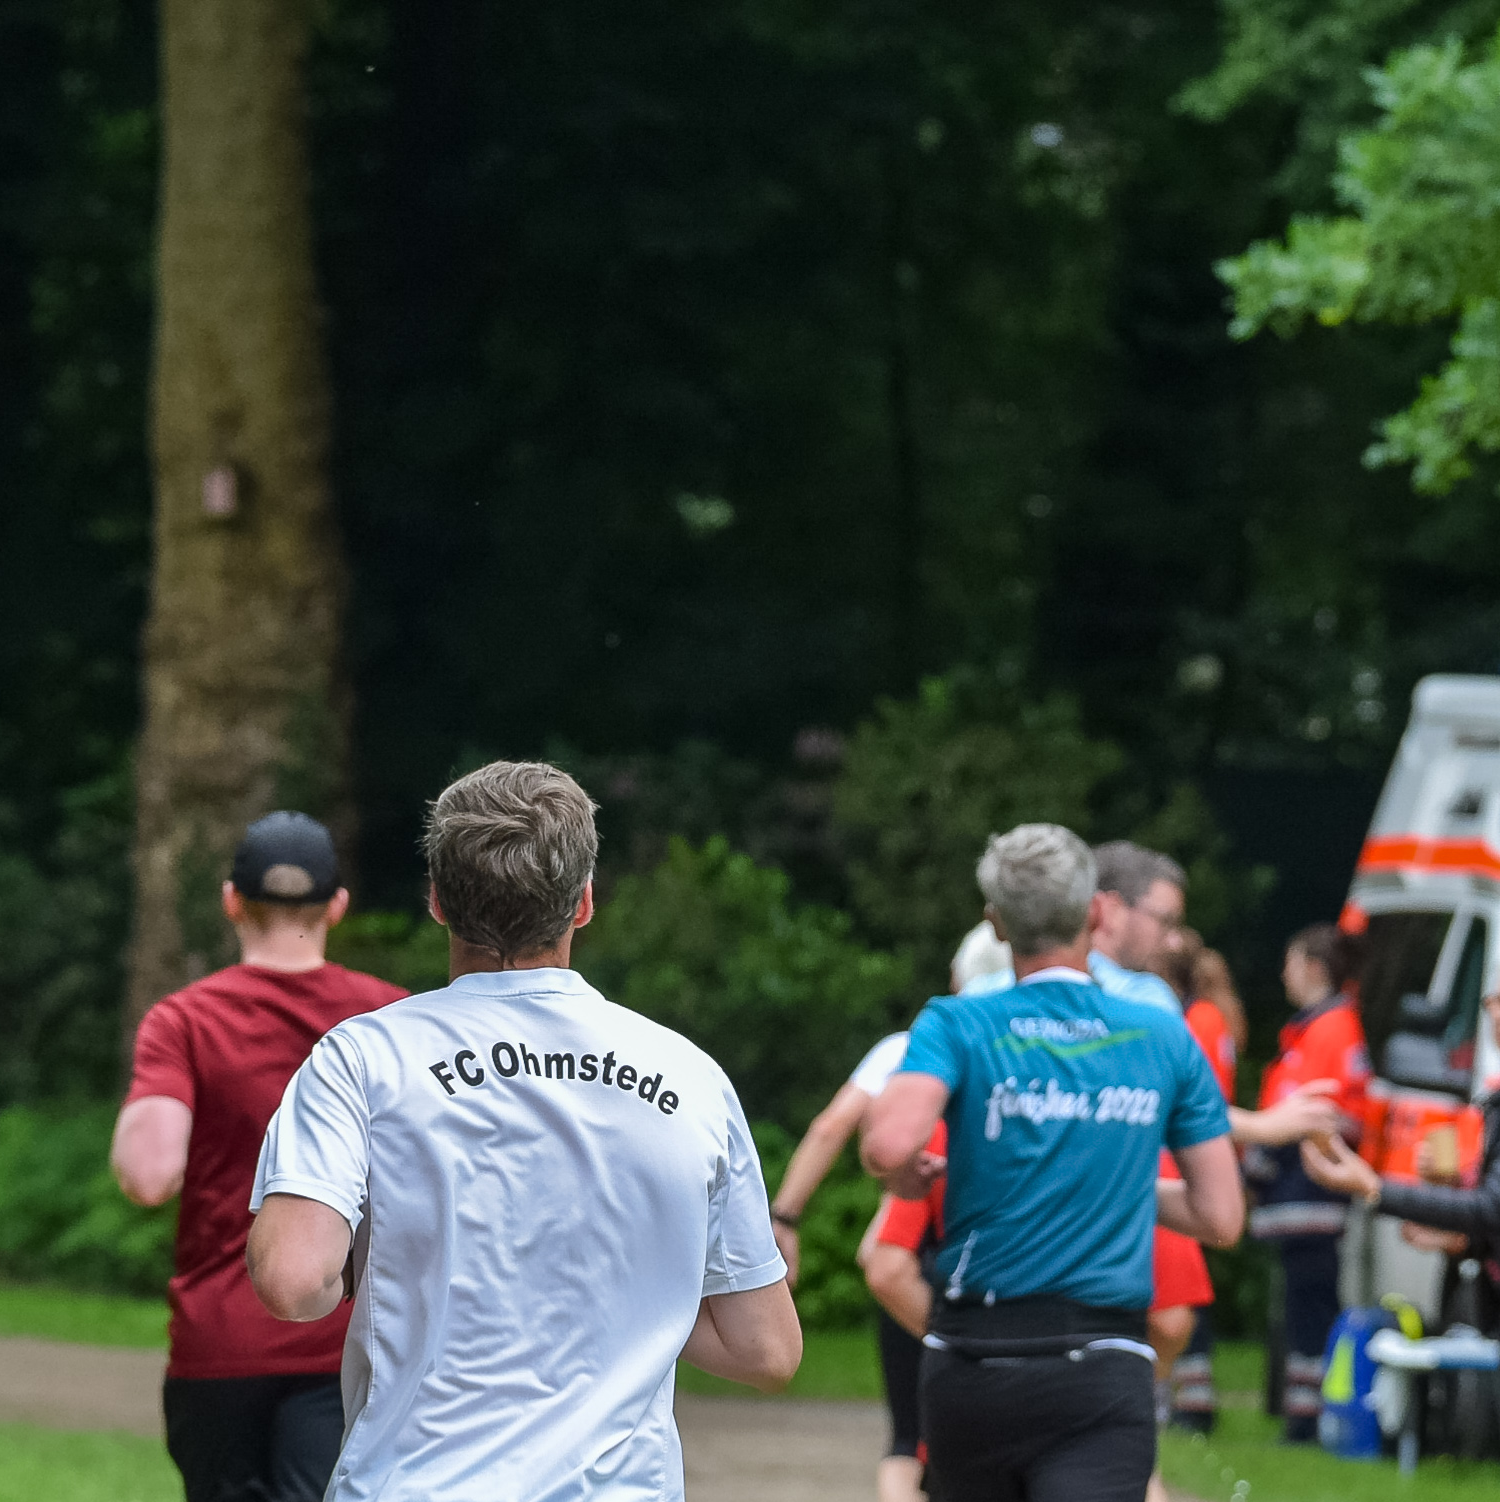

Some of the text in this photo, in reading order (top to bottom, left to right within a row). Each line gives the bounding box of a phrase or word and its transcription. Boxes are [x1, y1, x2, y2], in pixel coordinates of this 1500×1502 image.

[428, 1041, 680, 1115] FC Ohmstede
[1094, 1085, 1161, 1126] 2022
